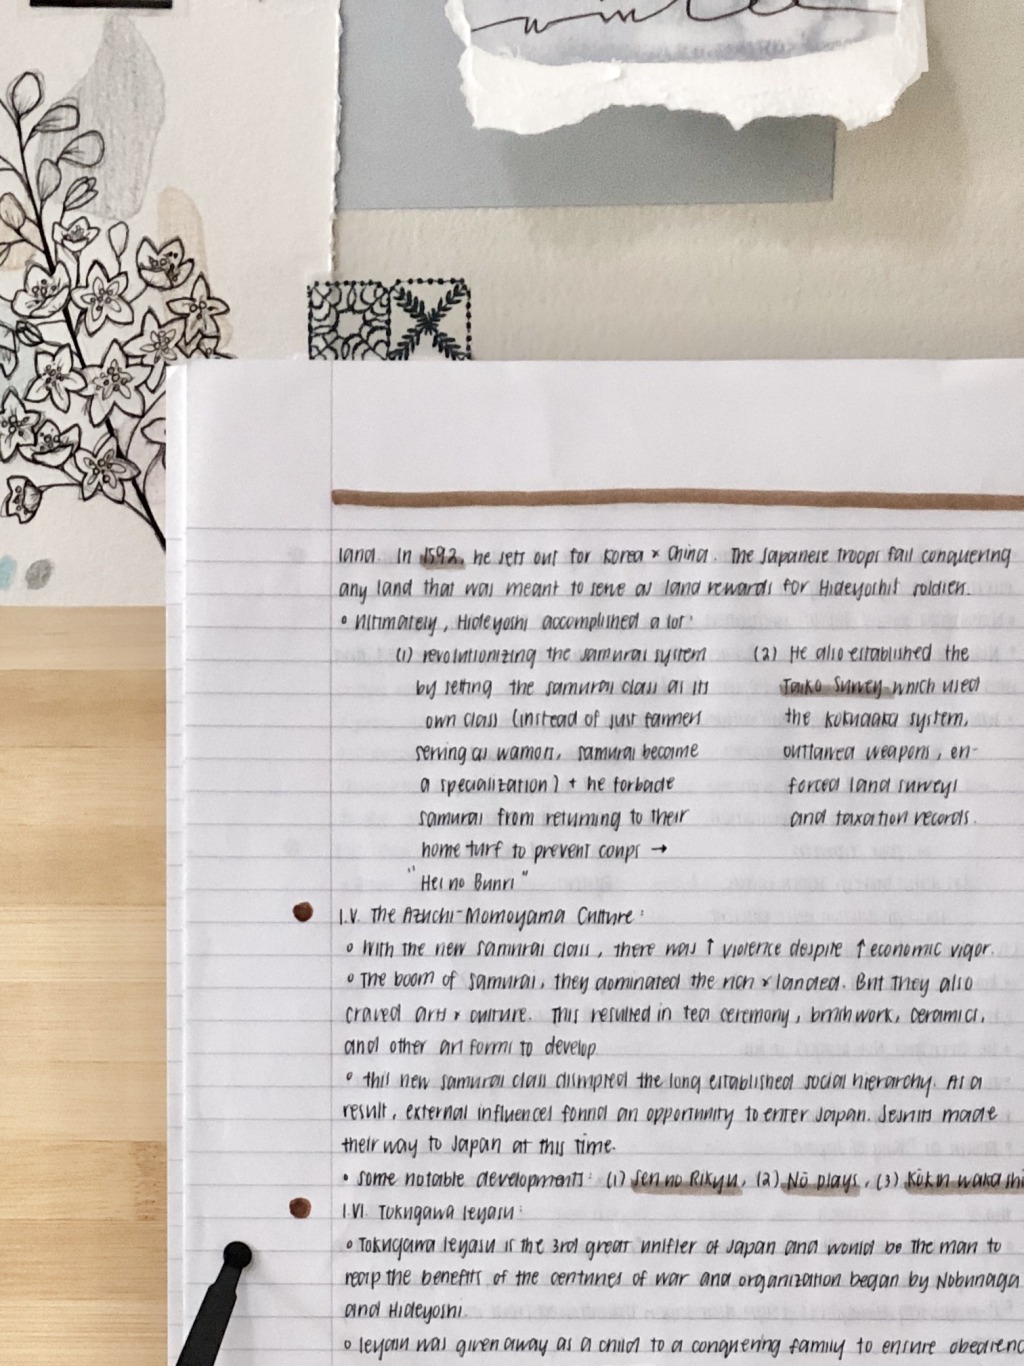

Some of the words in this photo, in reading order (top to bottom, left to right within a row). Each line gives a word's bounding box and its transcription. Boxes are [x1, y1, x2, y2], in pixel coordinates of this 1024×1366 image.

[339, 583, 367, 604] any
[377, 579, 412, 597] land
[424, 578, 454, 597] that
[465, 583, 493, 597] was
[506, 581, 558, 598] meant
[571, 581, 583, 596] to
[635, 582, 652, 597] as
[663, 579, 701, 596] land
[708, 580, 772, 596] rewards
[783, 578, 808, 596] for
[457, 613, 528, 636] Hideyoshi
[541, 612, 639, 632] accomplished
[650, 617, 660, 629] a
[422, 648, 536, 669] revolutionizing
[547, 647, 571, 662] the
[579, 648, 647, 662] samurai
[654, 647, 706, 667] system
[754, 646, 777, 662] (2)
[789, 646, 807, 662] He
[816, 644, 843, 662] also
[848, 643, 932, 662] established
[945, 644, 969, 662] the
[416, 680, 437, 700] by
[509, 680, 534, 696] the
[545, 680, 614, 696] samurai
[621, 679, 657, 695] class
[667, 680, 683, 695] as
[833, 676, 884, 699] Survey
[891, 678, 935, 696] which
[943, 677, 980, 694] used
[785, 708, 810, 726] the
[783, 744, 855, 761] outlawed
[788, 777, 840, 794] forced
[850, 777, 890, 793] land
[898, 779, 957, 799] surveys
[790, 809, 826, 827] and
[836, 810, 908, 827] taxation
[449, 878, 465, 891] no
[371, 905, 395, 924] The
[379, 1205, 454, 1226] Tokugawa
